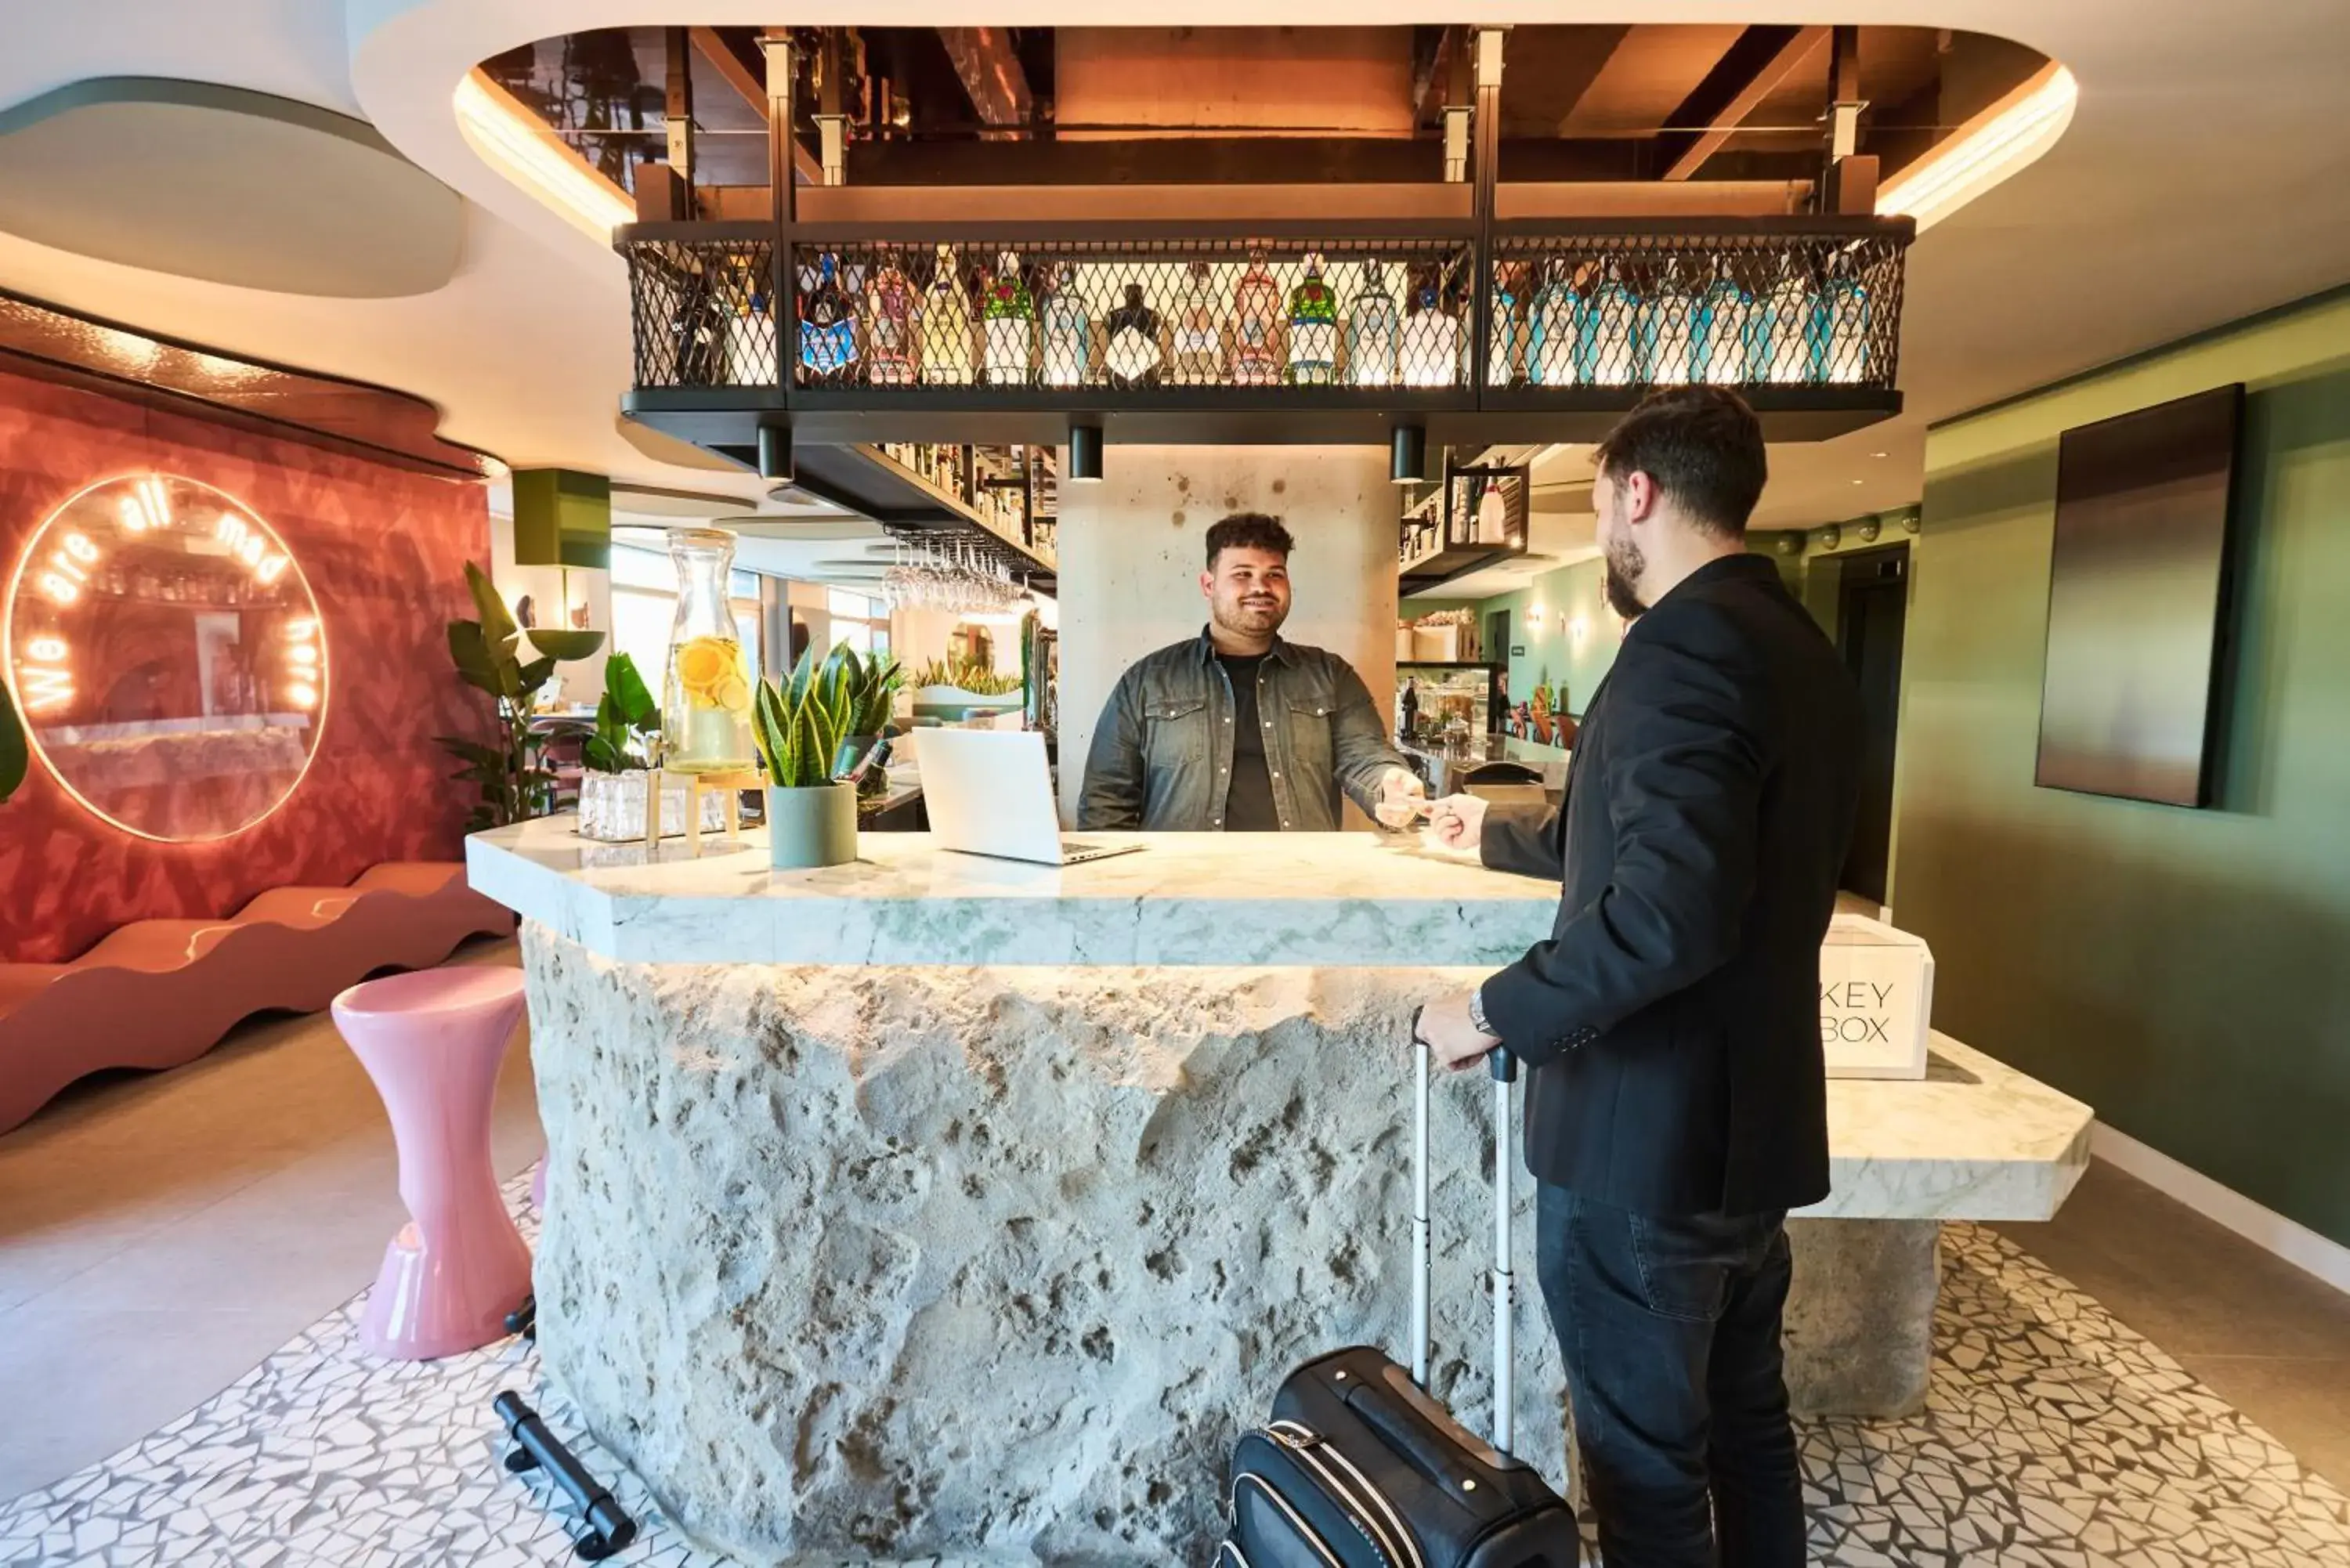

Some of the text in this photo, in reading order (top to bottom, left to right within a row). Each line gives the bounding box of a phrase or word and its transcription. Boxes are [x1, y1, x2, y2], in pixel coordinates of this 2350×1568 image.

[24, 477, 316, 710] We are all mad here
[1820, 981, 1893, 1009] KEY
[1820, 1017, 1890, 1042] BOX
